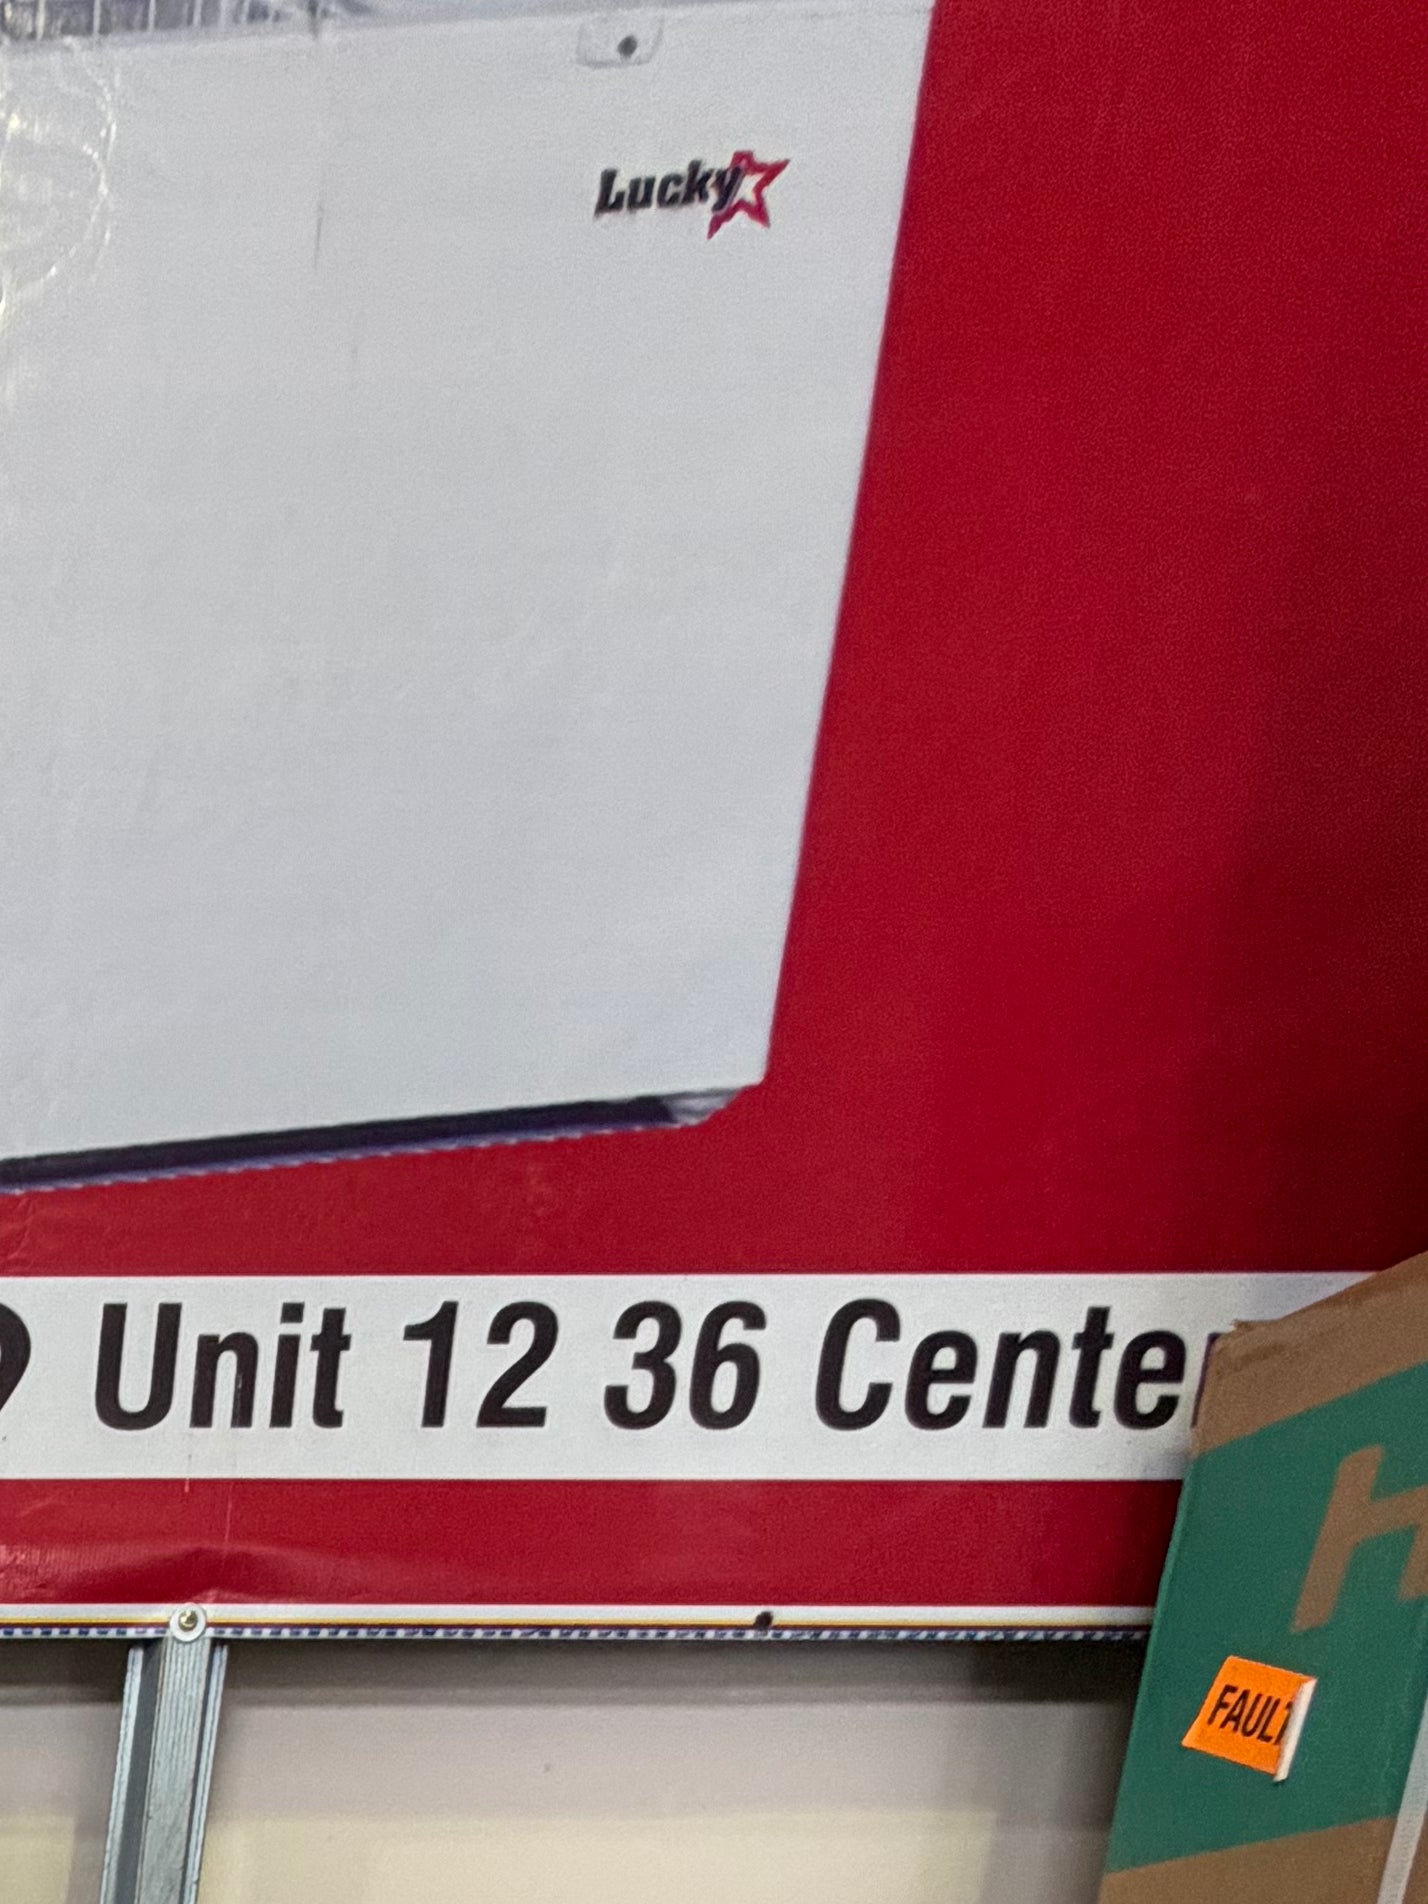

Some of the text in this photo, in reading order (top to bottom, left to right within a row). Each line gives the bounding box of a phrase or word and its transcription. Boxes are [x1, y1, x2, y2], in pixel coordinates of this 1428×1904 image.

[594, 159, 742, 219] Lucky
[94, 1298, 1221, 1432] Unit 12 36 Cente
